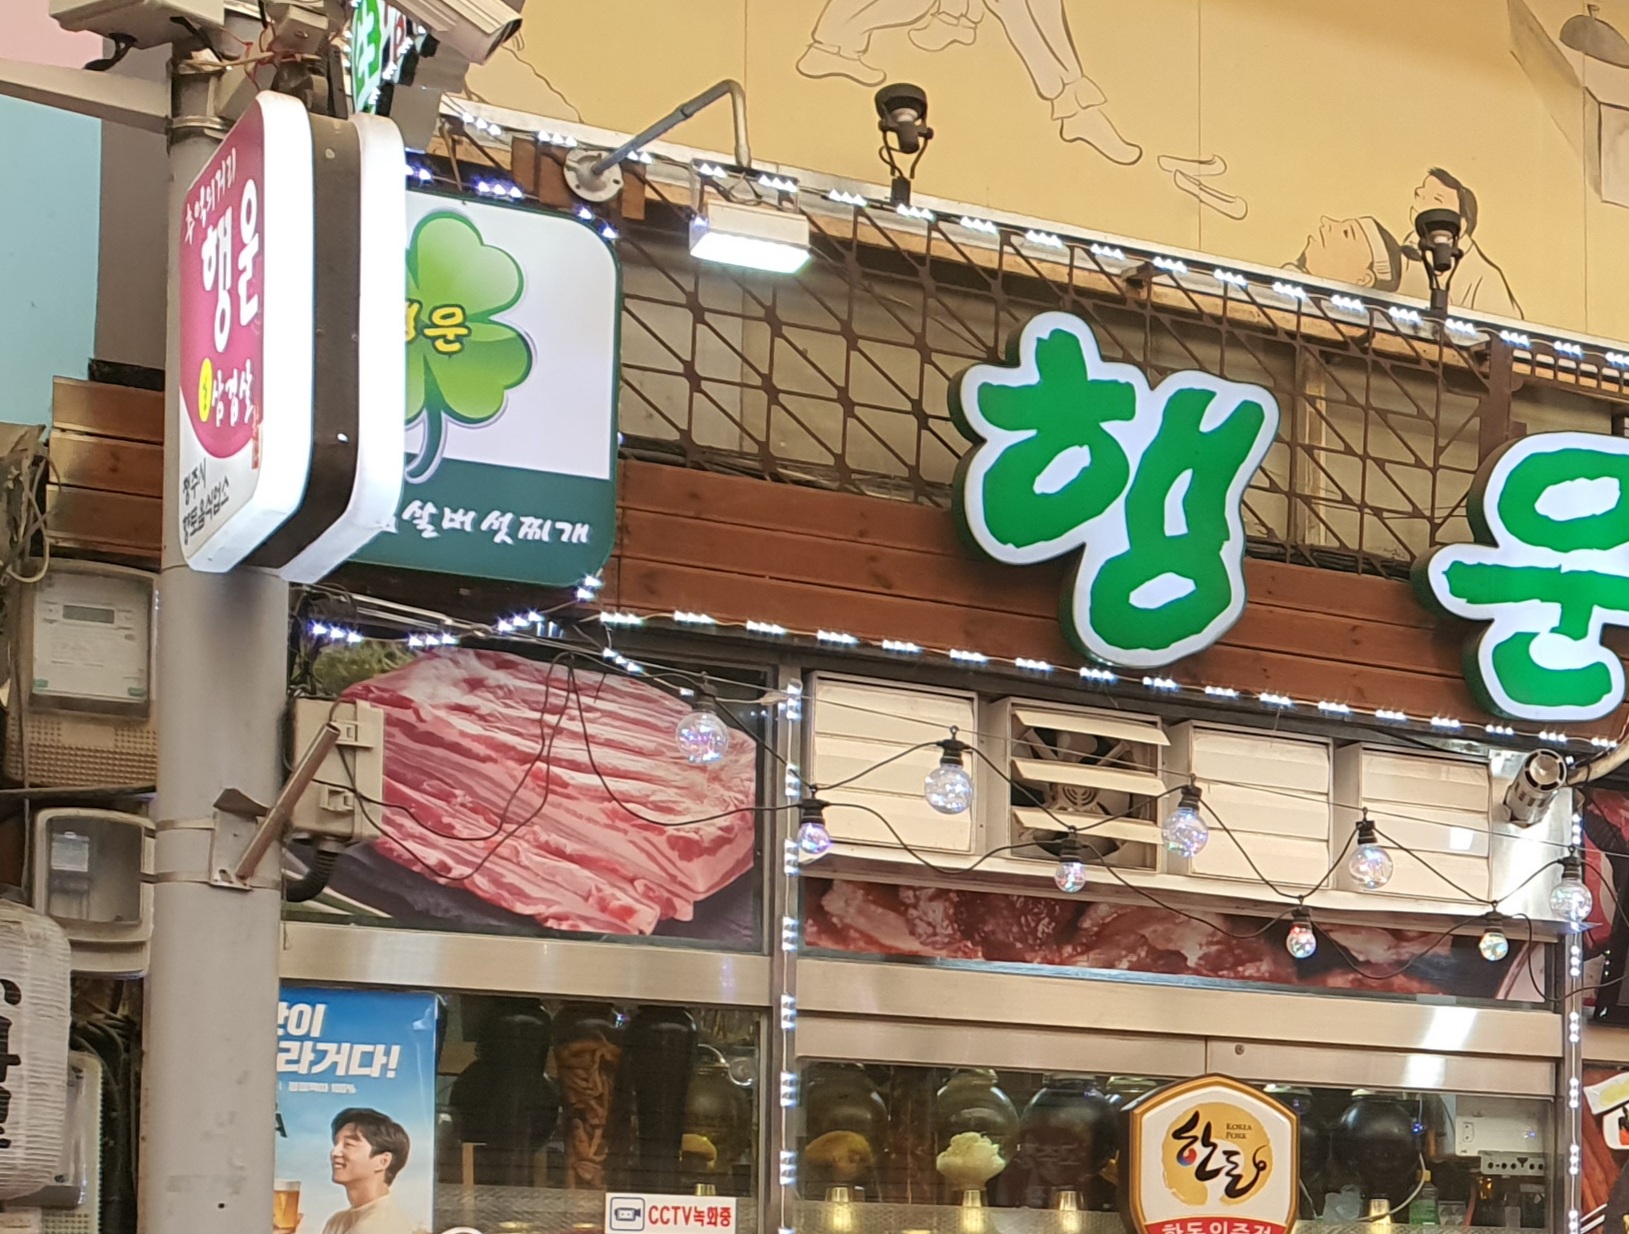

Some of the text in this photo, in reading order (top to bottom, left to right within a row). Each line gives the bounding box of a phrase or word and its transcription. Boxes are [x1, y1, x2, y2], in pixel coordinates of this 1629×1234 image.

[202, 179, 259, 352] 행운
[212, 359, 254, 427] 삼겹살
[648, 1205, 732, 1228] CCTV녹화중
